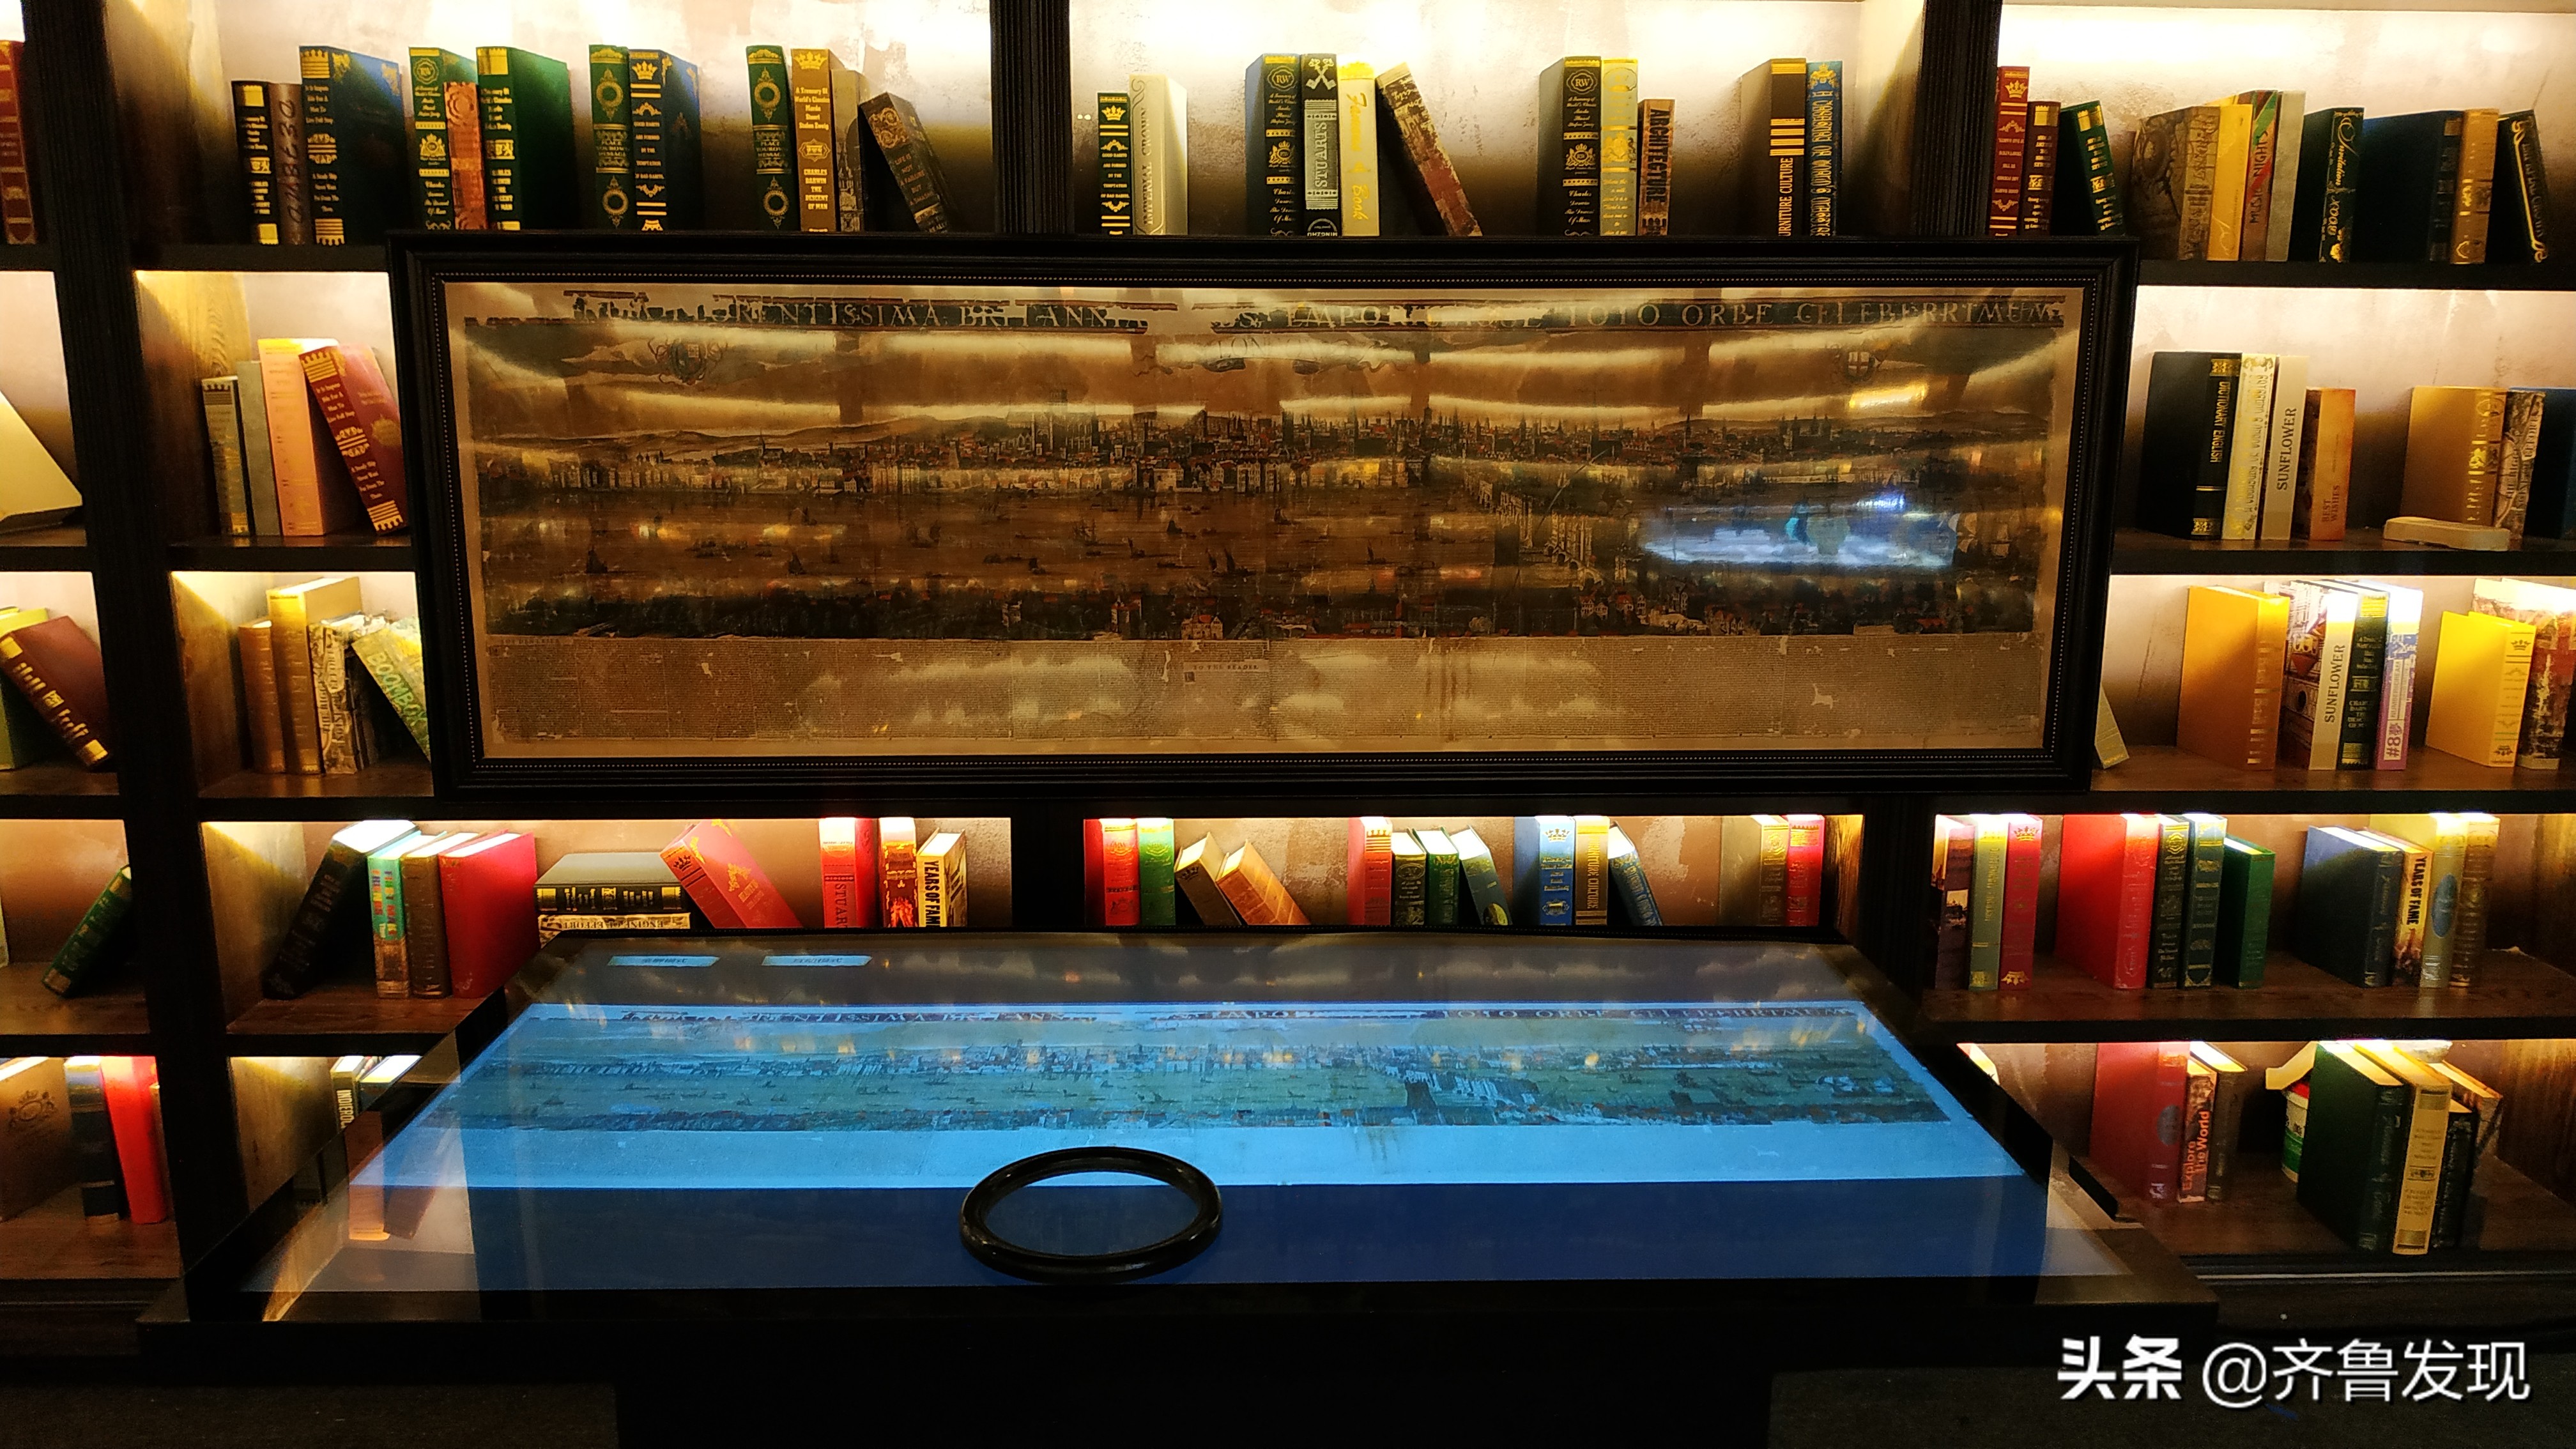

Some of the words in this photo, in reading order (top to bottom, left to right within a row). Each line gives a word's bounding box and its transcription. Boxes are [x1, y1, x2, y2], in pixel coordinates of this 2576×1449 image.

[1575, 77, 1590, 88] RW
[1315, 121, 1328, 188] STUARTS
[1646, 108, 1669, 203] ARCHITECTURE
[1779, 157, 1793, 194] CULTURE
[1142, 162, 1153, 225] IMPERIAL
[2250, 187, 2264, 224] MUSIC
[1682, 304, 1775, 326] ORBE
[2214, 381, 2231, 427] DICTIONARY
[2210, 429, 2227, 463] ENGLISH
[2276, 407, 2297, 491] SUNFLOWER
[2322, 500, 2332, 523] BEST
[366, 652, 429, 727] BOOMBOX
[2324, 643, 2346, 723] SUNFLOWER
[924, 860, 940, 893] YEARS
[2411, 856, 2427, 887] YEARS
[834, 883, 848, 928] STUAR
[924, 893, 940, 904] OF
[1587, 878, 1600, 909] CULTURE
[2409, 888, 2423, 899] OF
[564, 921, 604, 929] EFFORT
[627, 920, 664, 929] ENGINE
[925, 905, 940, 927] FAM
[2406, 900, 2421, 925] FAME
[2196, 1110, 2211, 1151] World
[2182, 1140, 2196, 1191] Explore
